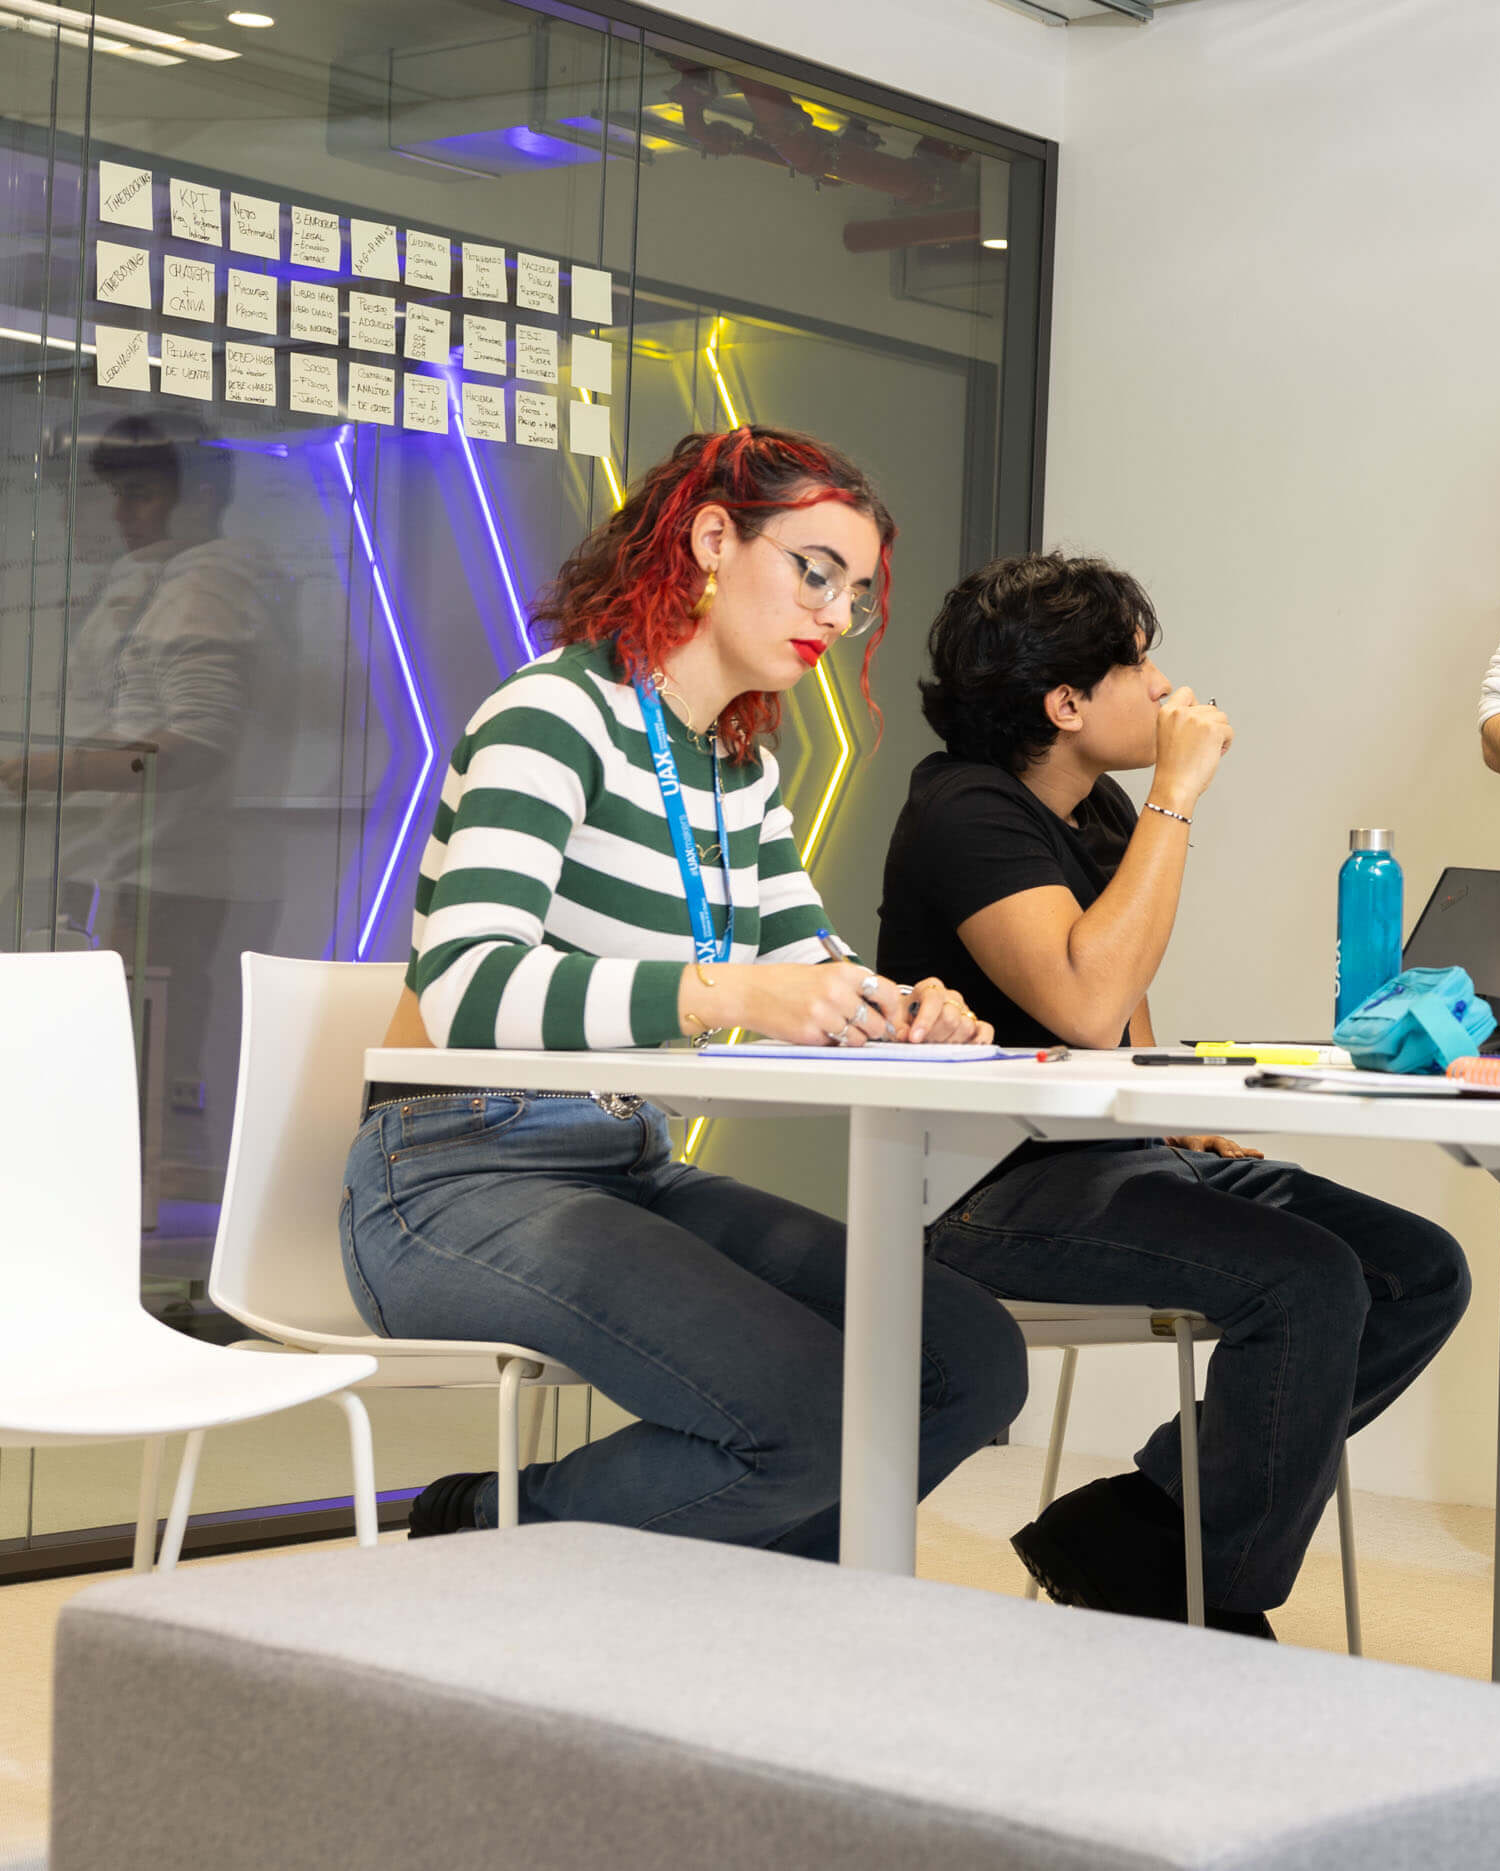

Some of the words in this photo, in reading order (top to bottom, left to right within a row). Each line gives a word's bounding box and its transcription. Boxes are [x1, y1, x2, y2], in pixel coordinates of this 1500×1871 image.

[179, 187, 214, 213] KPI
[169, 296, 207, 312] CANVA
[653, 750, 681, 797] UAX
[695, 938, 714, 964] AX
